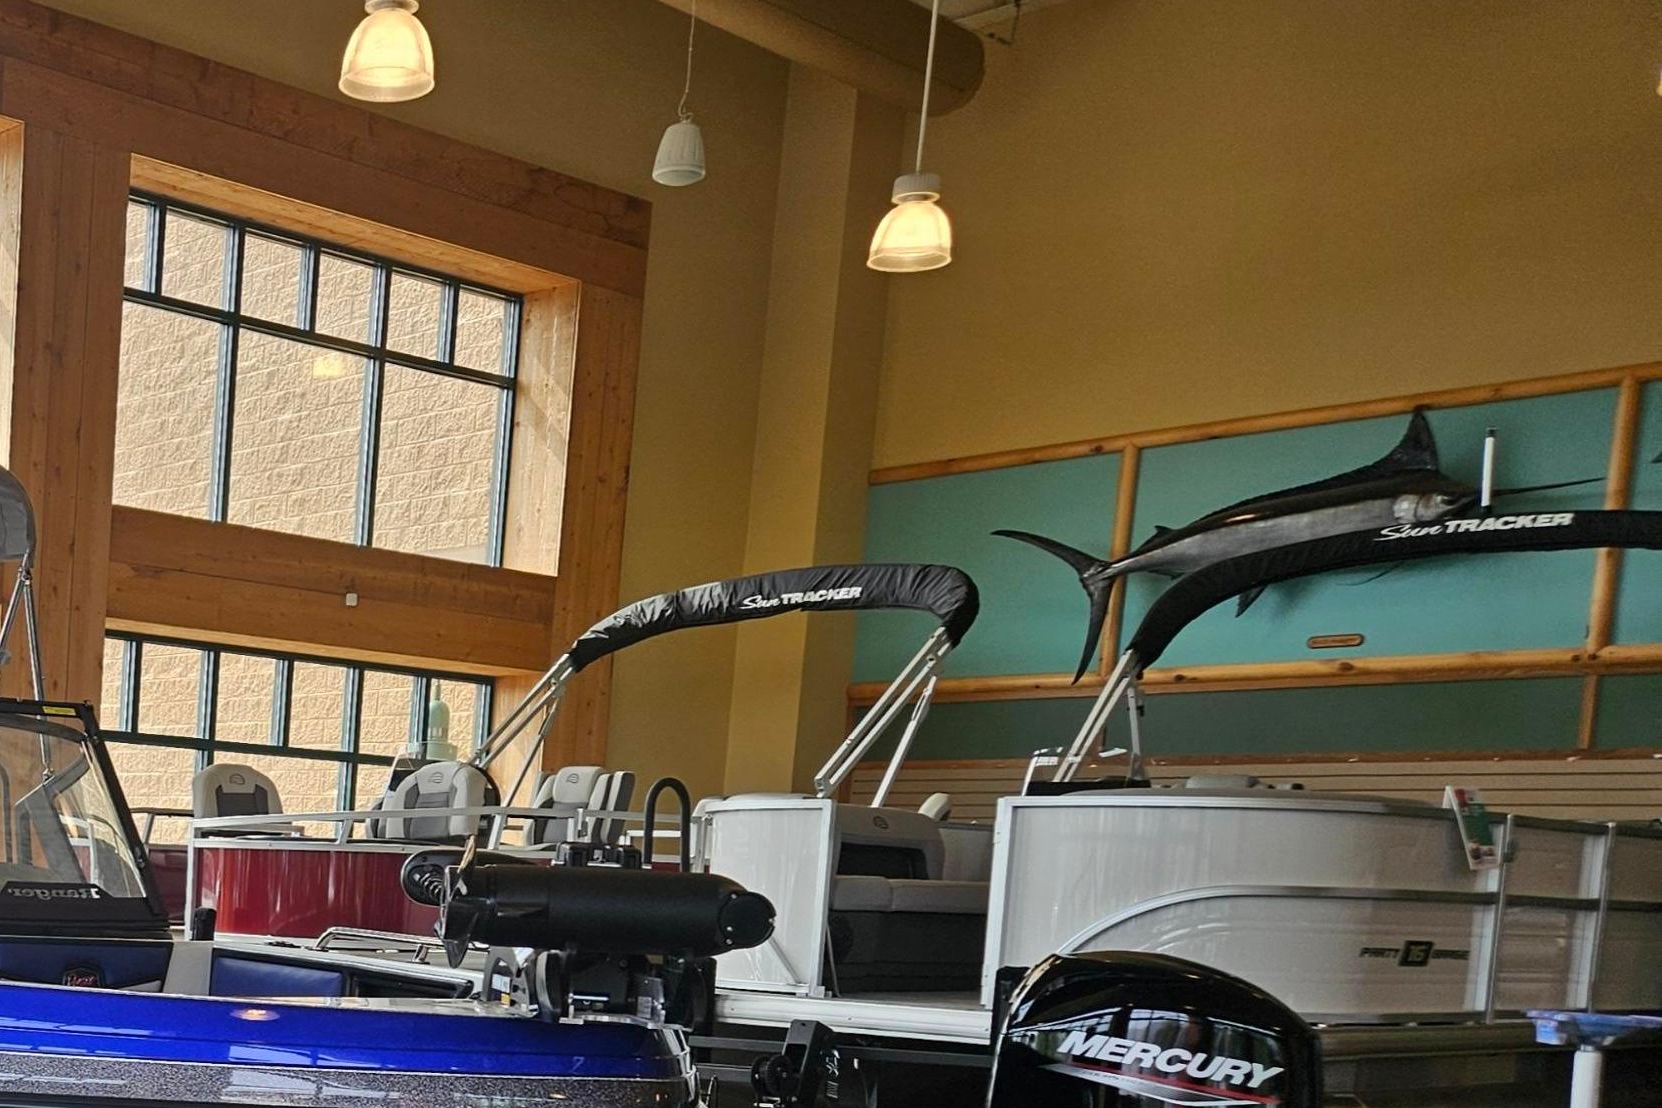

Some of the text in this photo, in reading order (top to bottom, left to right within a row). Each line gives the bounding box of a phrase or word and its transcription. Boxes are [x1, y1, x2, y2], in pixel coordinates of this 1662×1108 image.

[1373, 512, 1575, 541] Sun TRACKER
[739, 586, 862, 610] Sun TRACKER
[1057, 1031, 1285, 1088] MERCURY
